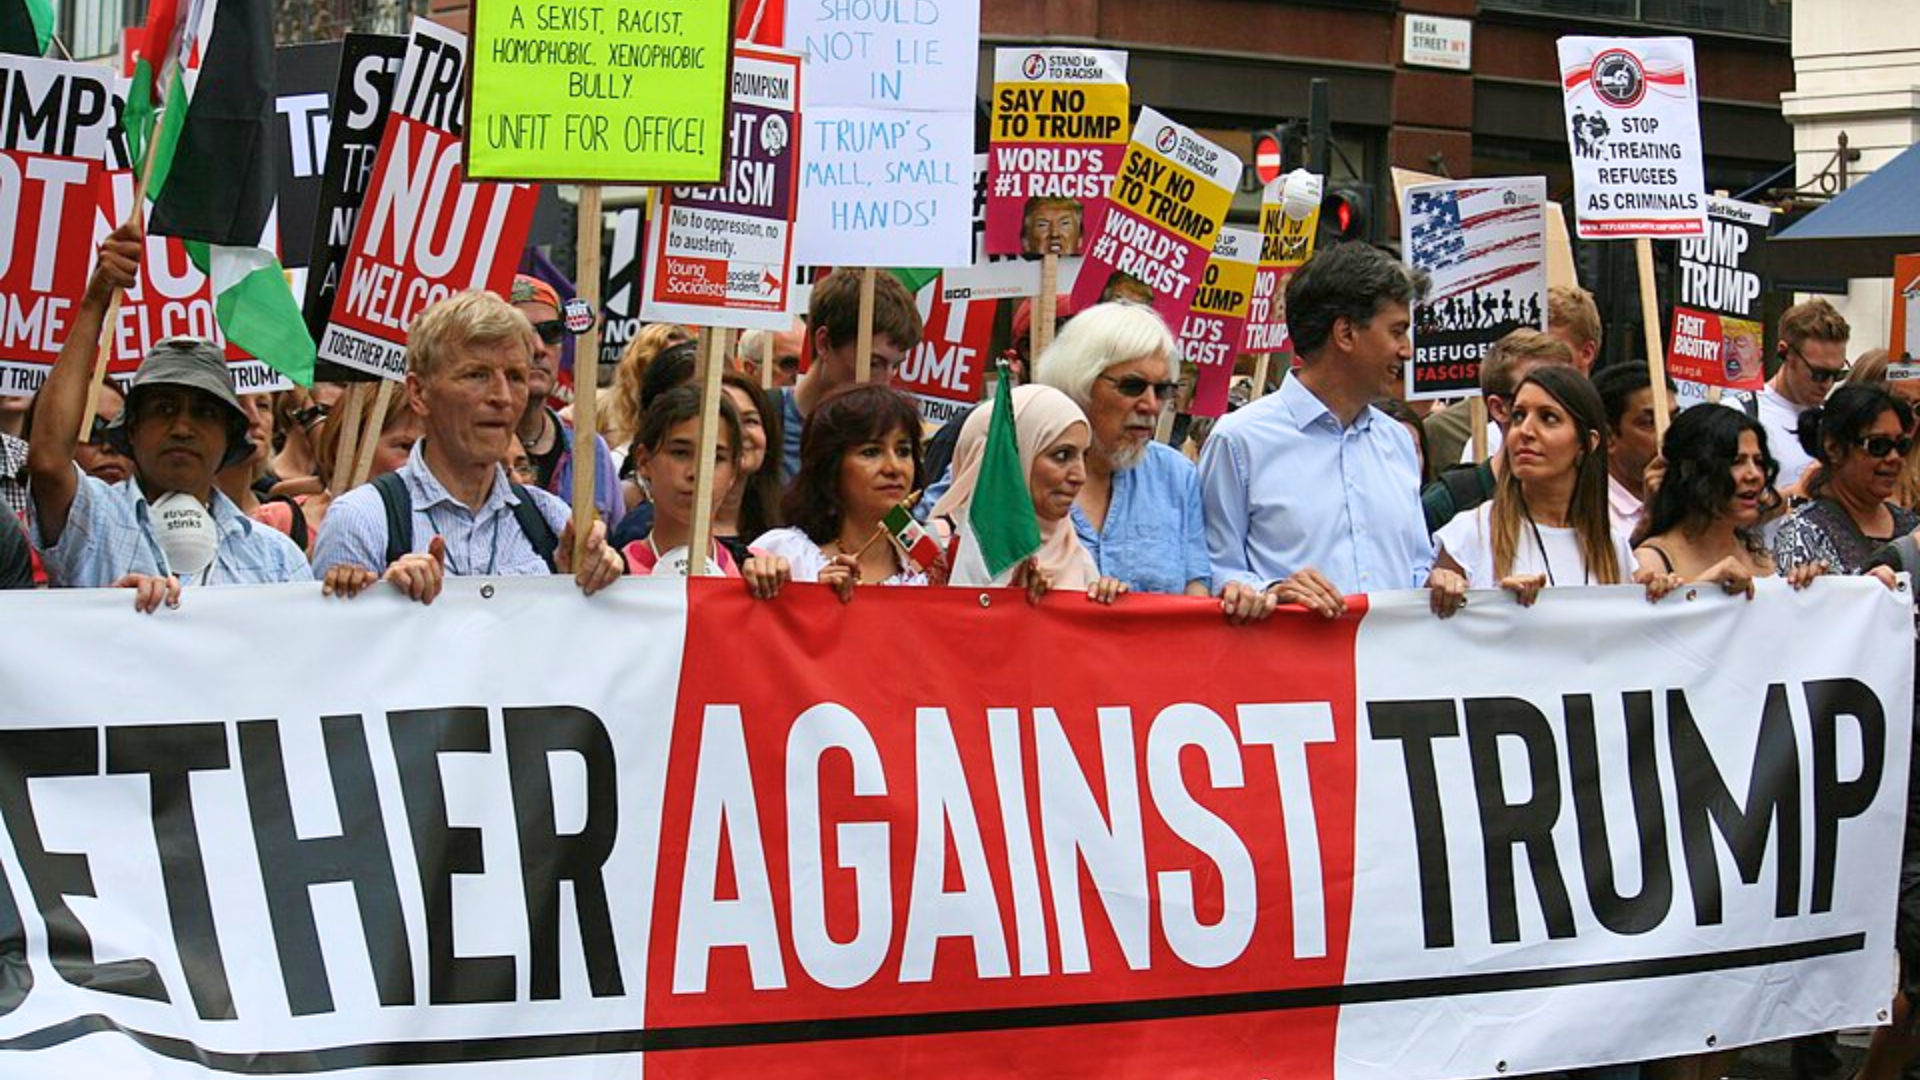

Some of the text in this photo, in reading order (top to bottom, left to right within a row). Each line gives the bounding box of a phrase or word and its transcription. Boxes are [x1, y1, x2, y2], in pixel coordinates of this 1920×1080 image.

[510, 6, 524, 29] A
[817, 0, 939, 25] SHOULD
[1413, 22, 1437, 34] BEAK
[608, 43, 705, 69] XENOPHOBIC
[805, 31, 943, 65] NOT LIE
[1413, 36, 1448, 50] STREET
[1049, 56, 1080, 67] STAND
[1049, 68, 1103, 80] TO RACISM
[733, 72, 789, 100] RUMPISM
[870, 69, 901, 101] IN
[999, 90, 1085, 113] SAY NO
[487, 114, 705, 155] UNFIT FOR OFFICE!
[814, 119, 932, 152] TRUMP'S
[998, 114, 1121, 140] TO TRUMP
[1621, 117, 1659, 133] STOP
[996, 147, 1104, 173] WORLD'S
[1179, 135, 1219, 162] STAND UP
[1609, 142, 1681, 159] TREATING
[885, 159, 959, 185] SMALL
[1174, 148, 1217, 179] TO RACISM
[1598, 168, 1678, 185] REFUGEES
[994, 173, 1023, 198] #1
[1028, 174, 1116, 199] RACIST
[1125, 150, 1196, 204] SAY NO
[831, 199, 937, 231] HANDS!
[1117, 173, 1216, 243] TO TRUMP
[1587, 193, 1699, 211] AS CRIMINALS
[672, 210, 779, 240] No to oppression, no
[669, 231, 737, 258] to austerity.
[1101, 207, 1190, 270] WORLD'S
[666, 259, 706, 279] Young
[1093, 235, 1118, 266] #1
[1116, 246, 1192, 300] RACIST
[666, 277, 726, 297] Socialists
[1254, 271, 1276, 297] NO
[1680, 260, 1761, 315] TRUMP
[1251, 298, 1271, 324] TO
[1245, 323, 1290, 350] TRUMP
[1677, 313, 1706, 336] FIGHT
[327, 330, 383, 367] TOGETHER
[1175, 336, 1233, 367] ACIST
[1674, 333, 1721, 361] BIGOTRY
[167, 519, 202, 530] stinks
[672, 701, 1336, 995] AGAINST
[1366, 676, 1886, 950] TRUMP
